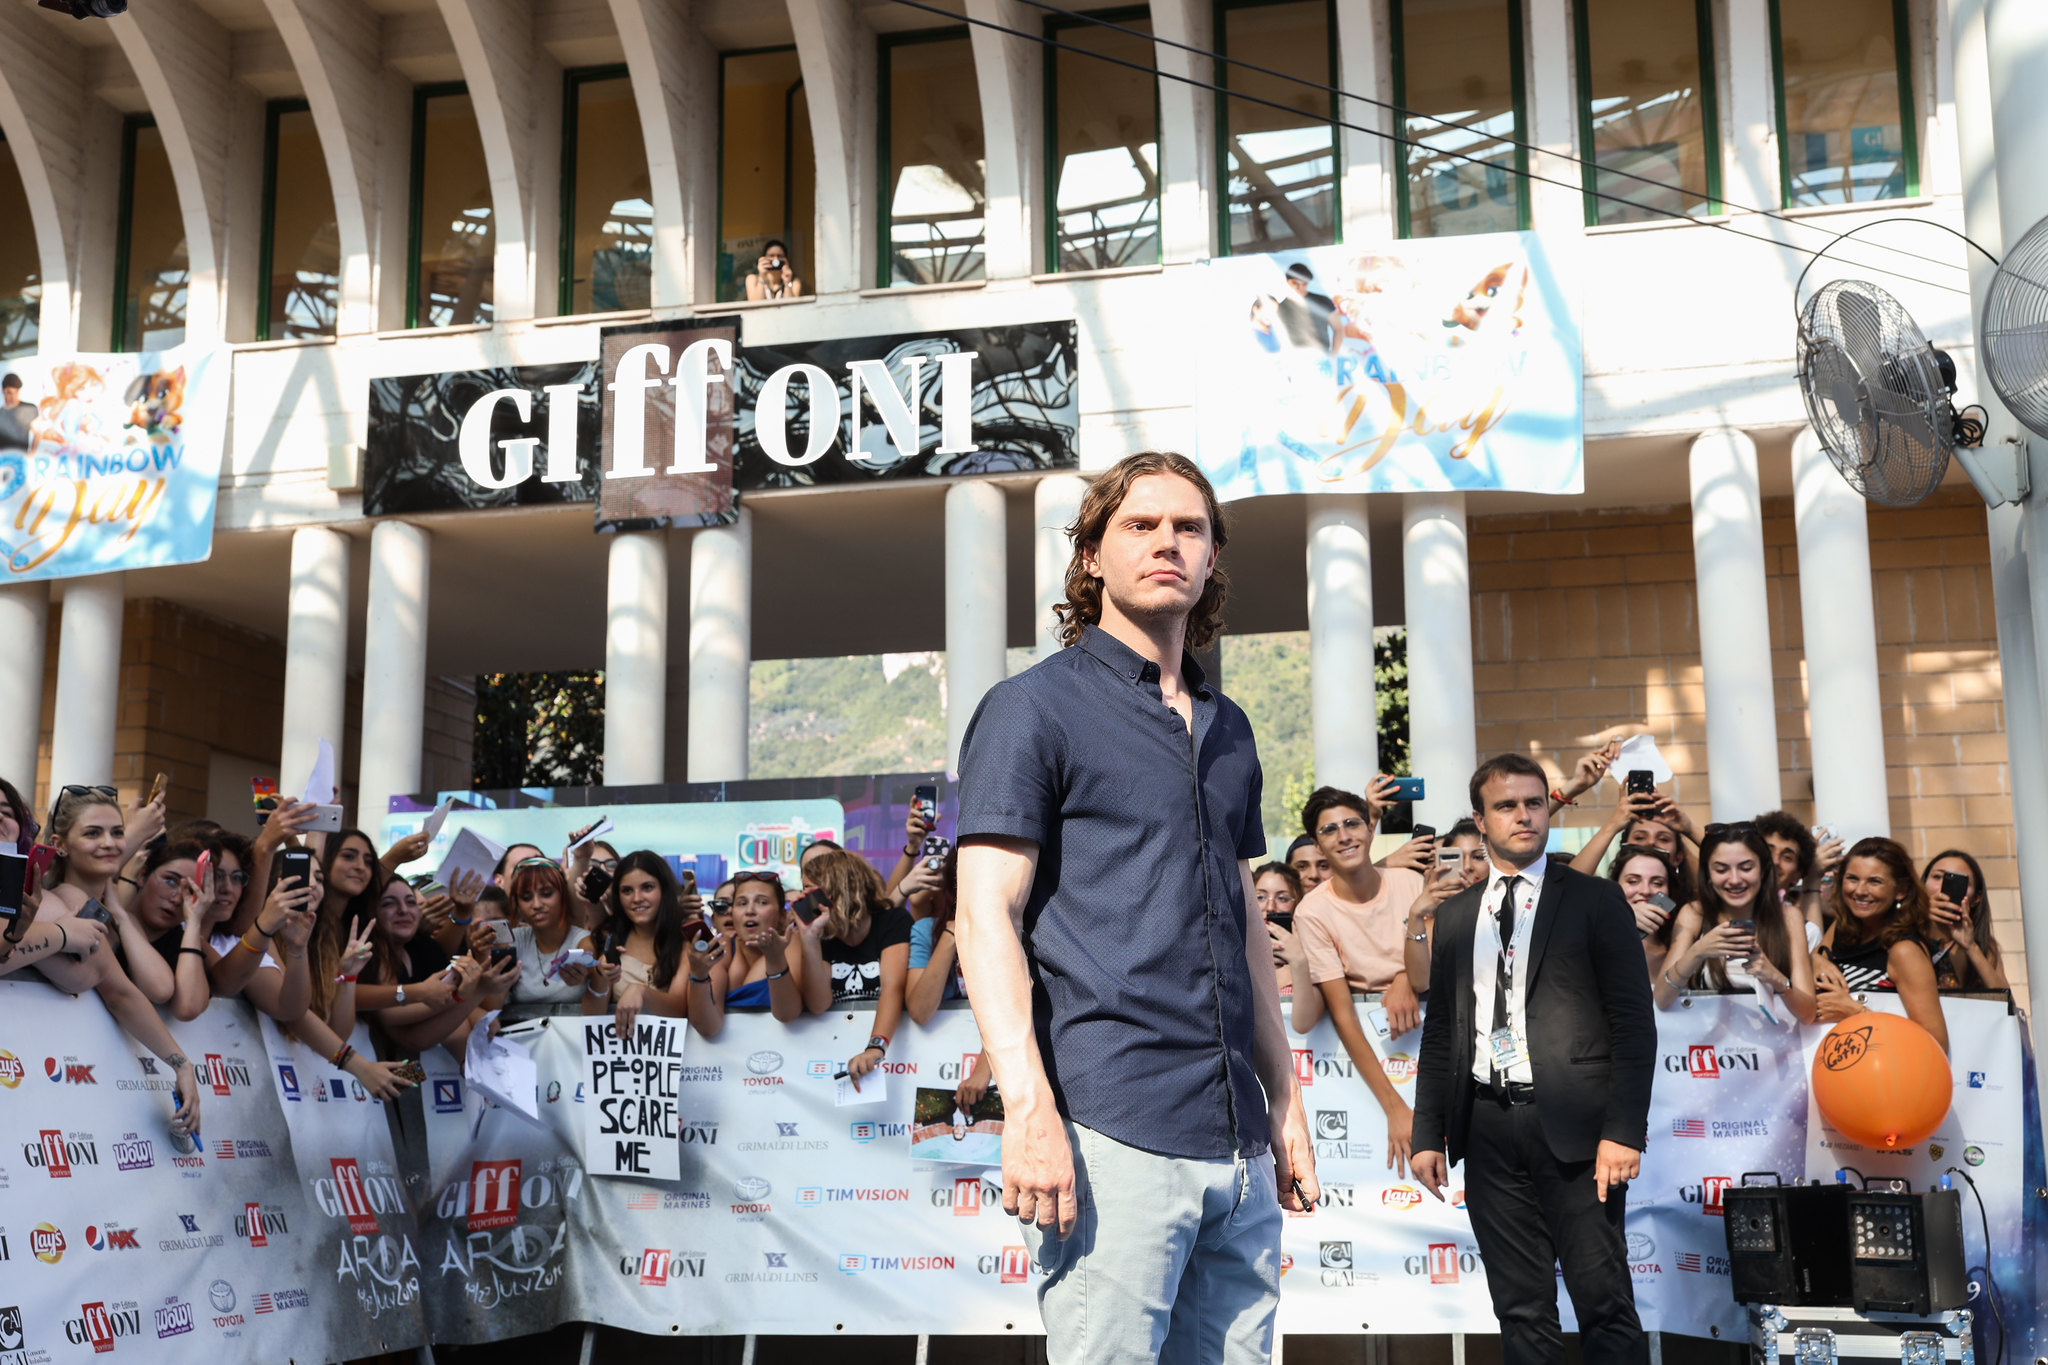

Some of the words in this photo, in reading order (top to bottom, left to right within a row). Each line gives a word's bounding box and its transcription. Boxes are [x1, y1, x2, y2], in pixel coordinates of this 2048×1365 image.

[36, 444, 186, 482] RAINBOW
[740, 836, 796, 865] CLUB
[65, 1064, 97, 1084] MAX
[592, 1057, 681, 1098] PEOPLE
[743, 1076, 784, 1086] TOYOTA
[600, 1096, 678, 1139] SCARE
[1711, 1119, 1768, 1130] ORIGINAL
[1713, 1128, 1769, 1138] MARINES
[236, 1140, 269, 1149] ORIGINAL
[237, 1148, 272, 1158] MARINES
[615, 1141, 651, 1174] ME
[172, 1157, 205, 1168] TOYOTA
[664, 1192, 711, 1200] ORIGINAL
[663, 1201, 711, 1209] MARINES
[731, 1204, 771, 1214] TOYOTA
[33, 1228, 63, 1256] Lay's
[107, 1228, 140, 1250] MAX
[159, 1237, 205, 1252] GRIMALDI
[1628, 1263, 1662, 1274] YOTA
[725, 1272, 782, 1283] GRIMALDI
[785, 1272, 818, 1283] LINES
[273, 1288, 309, 1302] ORIGINAL
[276, 1298, 310, 1311] MARINES
[212, 1314, 245, 1328] TOYOTA
